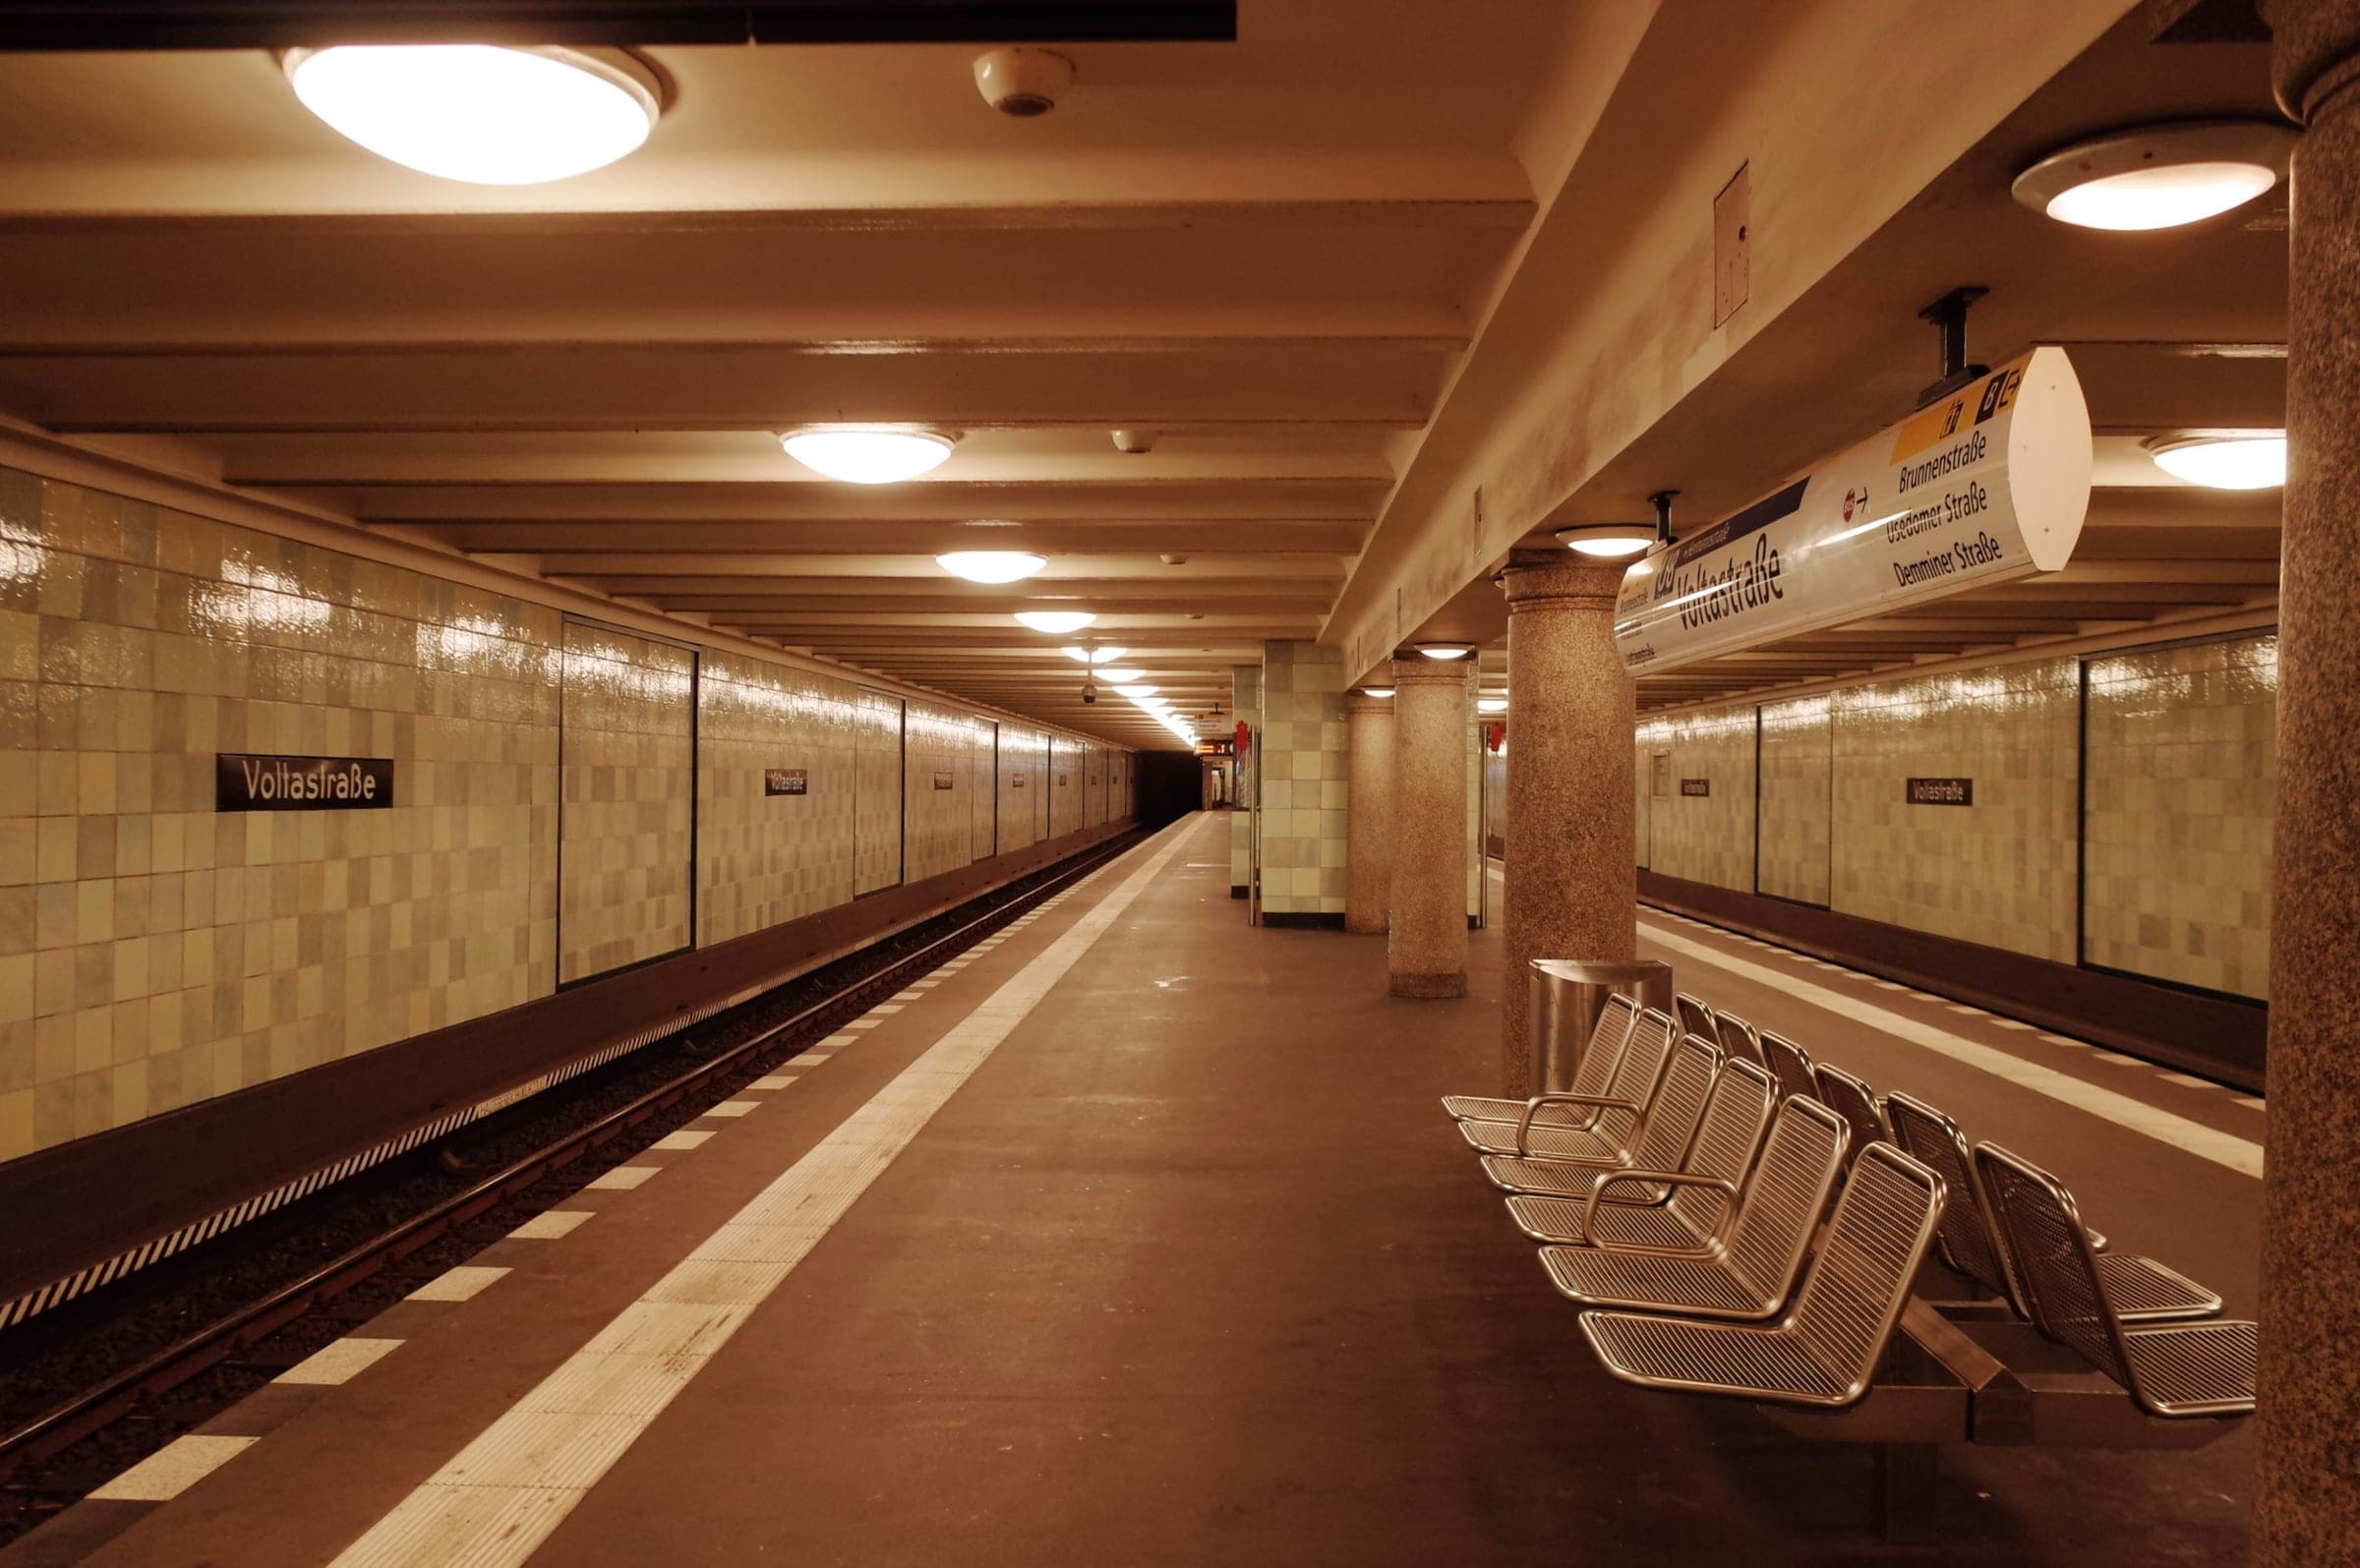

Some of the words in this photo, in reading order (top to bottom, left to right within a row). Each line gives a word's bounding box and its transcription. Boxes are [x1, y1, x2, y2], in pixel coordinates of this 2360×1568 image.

[1982, 381, 1999, 412] B
[1899, 431, 1986, 494] Brunnenstraße
[1887, 504, 1943, 544] Usedomer
[1944, 481, 1987, 523] Straße
[1678, 533, 1784, 630] Voltastraße
[1893, 552, 1957, 587] Demminer
[1954, 531, 2003, 569] Straße
[242, 759, 377, 800] Voltastraße
[1913, 780, 1965, 802] Voltastraße
